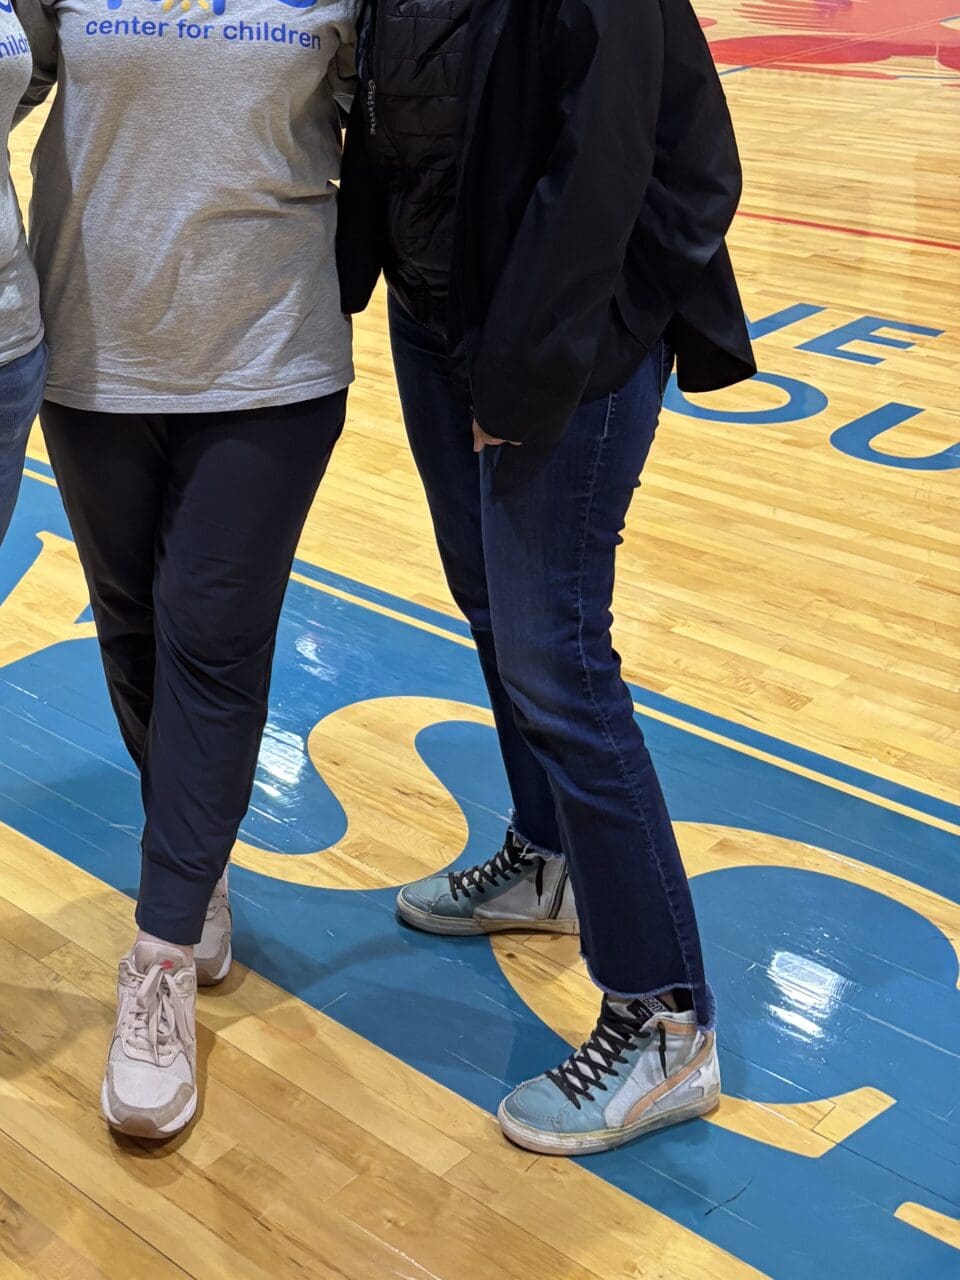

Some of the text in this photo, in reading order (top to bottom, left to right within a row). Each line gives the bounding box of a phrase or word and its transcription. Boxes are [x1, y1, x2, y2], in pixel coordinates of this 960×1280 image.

[86, 17, 321, 51] center for children
